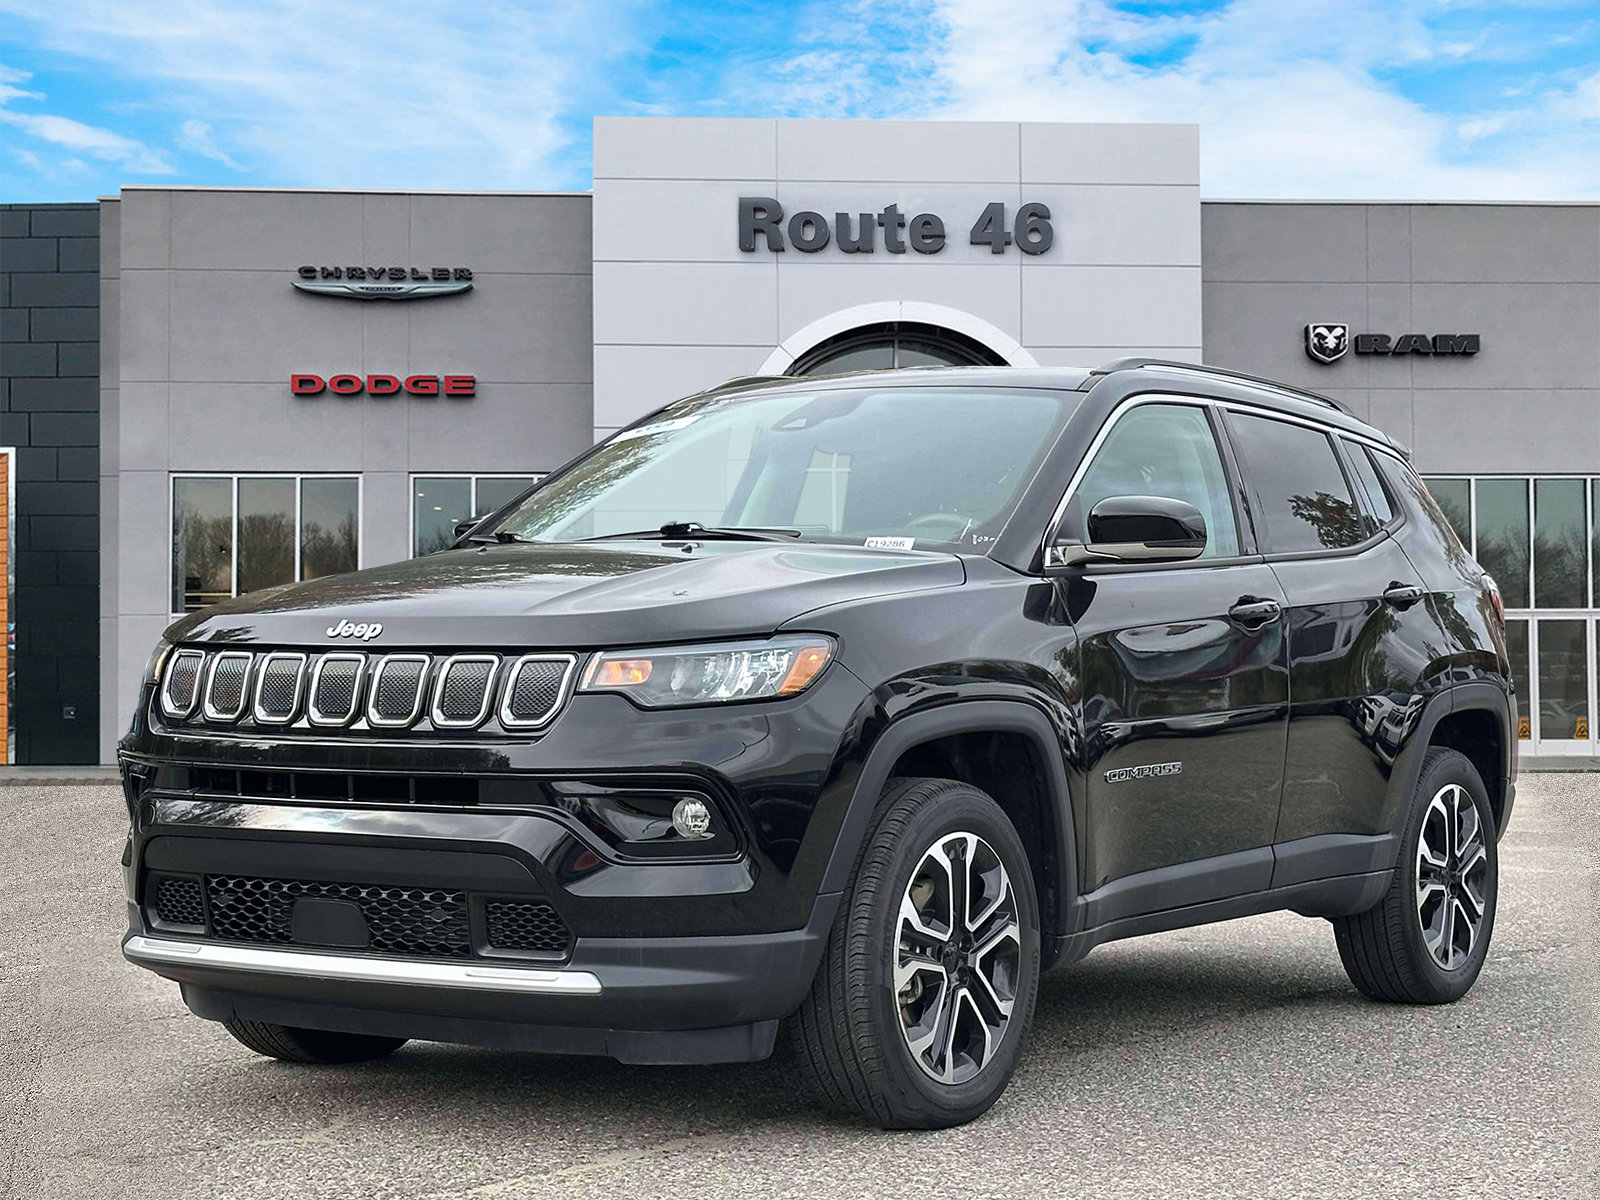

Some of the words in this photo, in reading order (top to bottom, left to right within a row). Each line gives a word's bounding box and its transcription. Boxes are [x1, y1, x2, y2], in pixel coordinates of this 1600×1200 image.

[738, 196, 946, 255] Route
[969, 201, 1055, 256] 46
[298, 265, 474, 281] CHRYSLER
[1355, 334, 1480, 355] RAM
[290, 373, 477, 397] DODGE
[326, 619, 383, 641] Jeep
[1105, 762, 1182, 783] COMPASS
